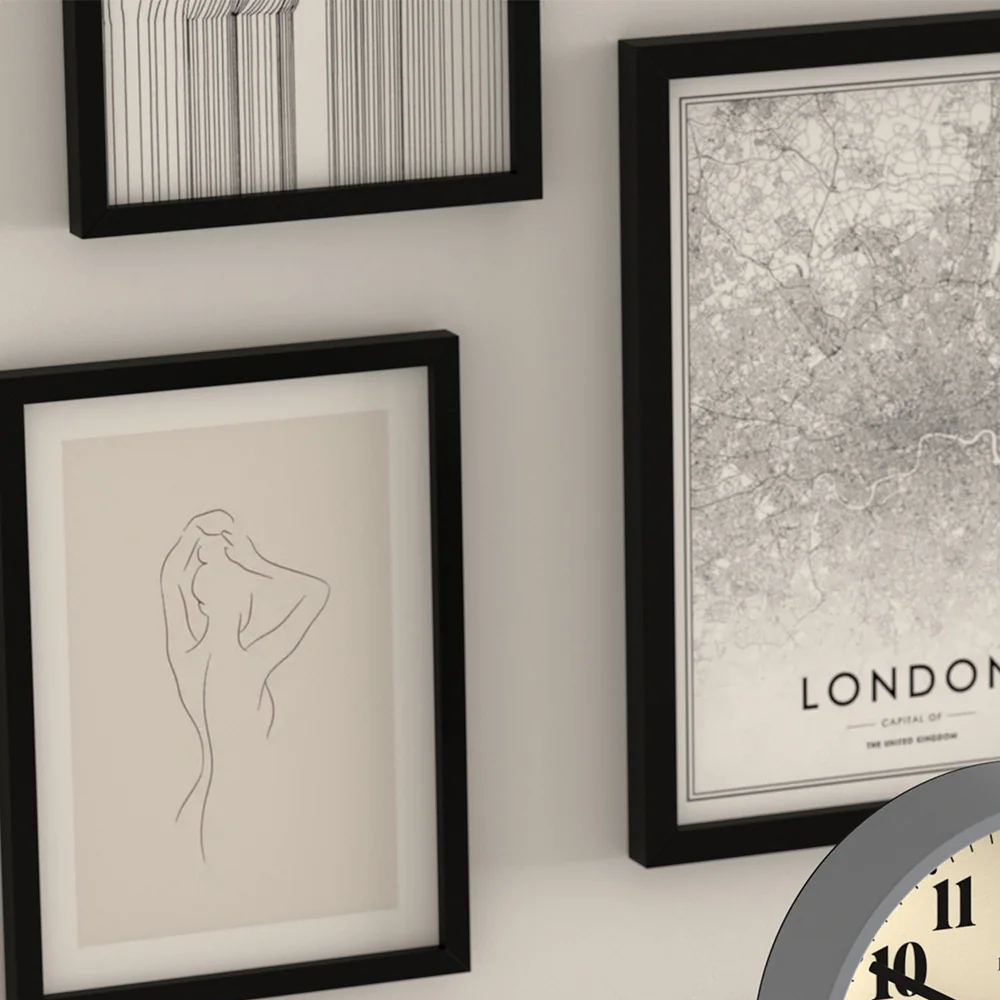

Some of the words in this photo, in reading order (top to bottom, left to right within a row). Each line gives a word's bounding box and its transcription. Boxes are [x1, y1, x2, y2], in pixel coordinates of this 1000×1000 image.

[881, 715, 924, 728] CAPITAL
[928, 712, 943, 722] OF
[866, 740, 881, 749] THE
[884, 737, 914, 748] UNITED
[916, 732, 958, 744] KINGDOM
[932, 876, 976, 931] 11
